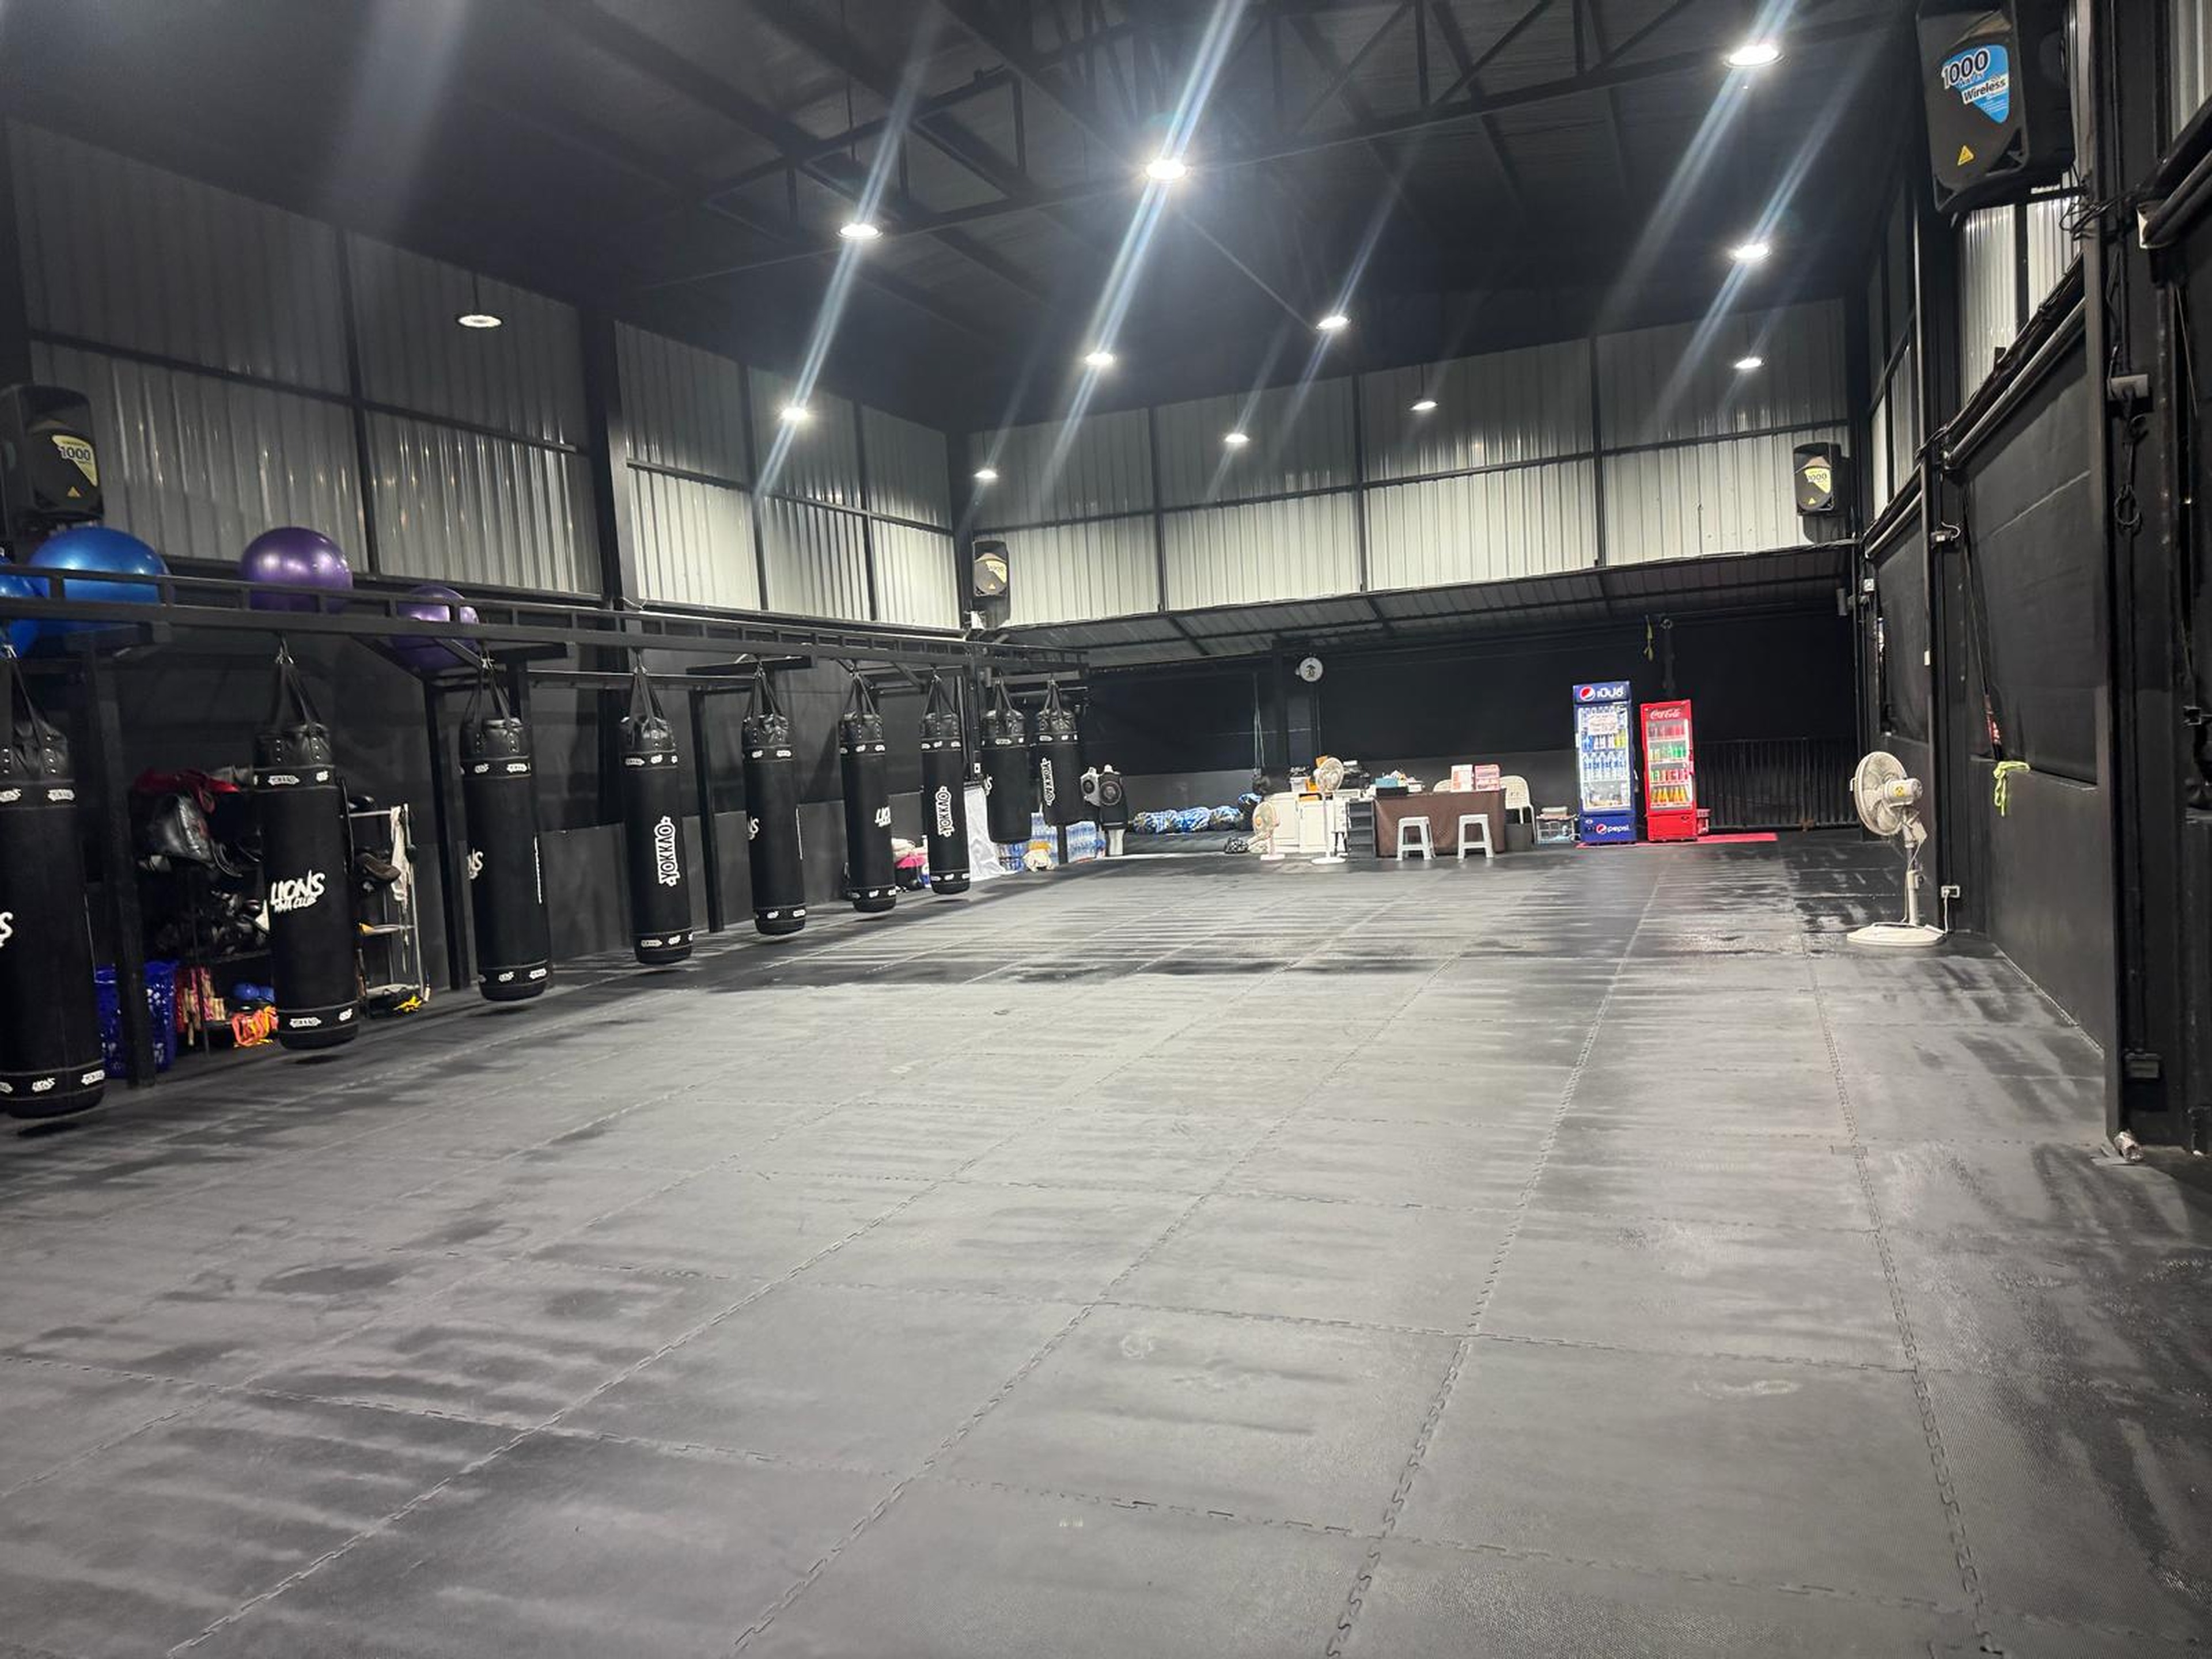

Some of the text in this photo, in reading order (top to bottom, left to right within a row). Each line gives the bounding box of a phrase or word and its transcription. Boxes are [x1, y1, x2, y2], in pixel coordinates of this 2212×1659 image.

[1942, 48, 1990, 89] 1000
[1963, 78, 2006, 102] Wireless
[60, 446, 90, 461] 1000
[657, 824, 679, 882] YOKKAO
[271, 869, 325, 905] LIONS
